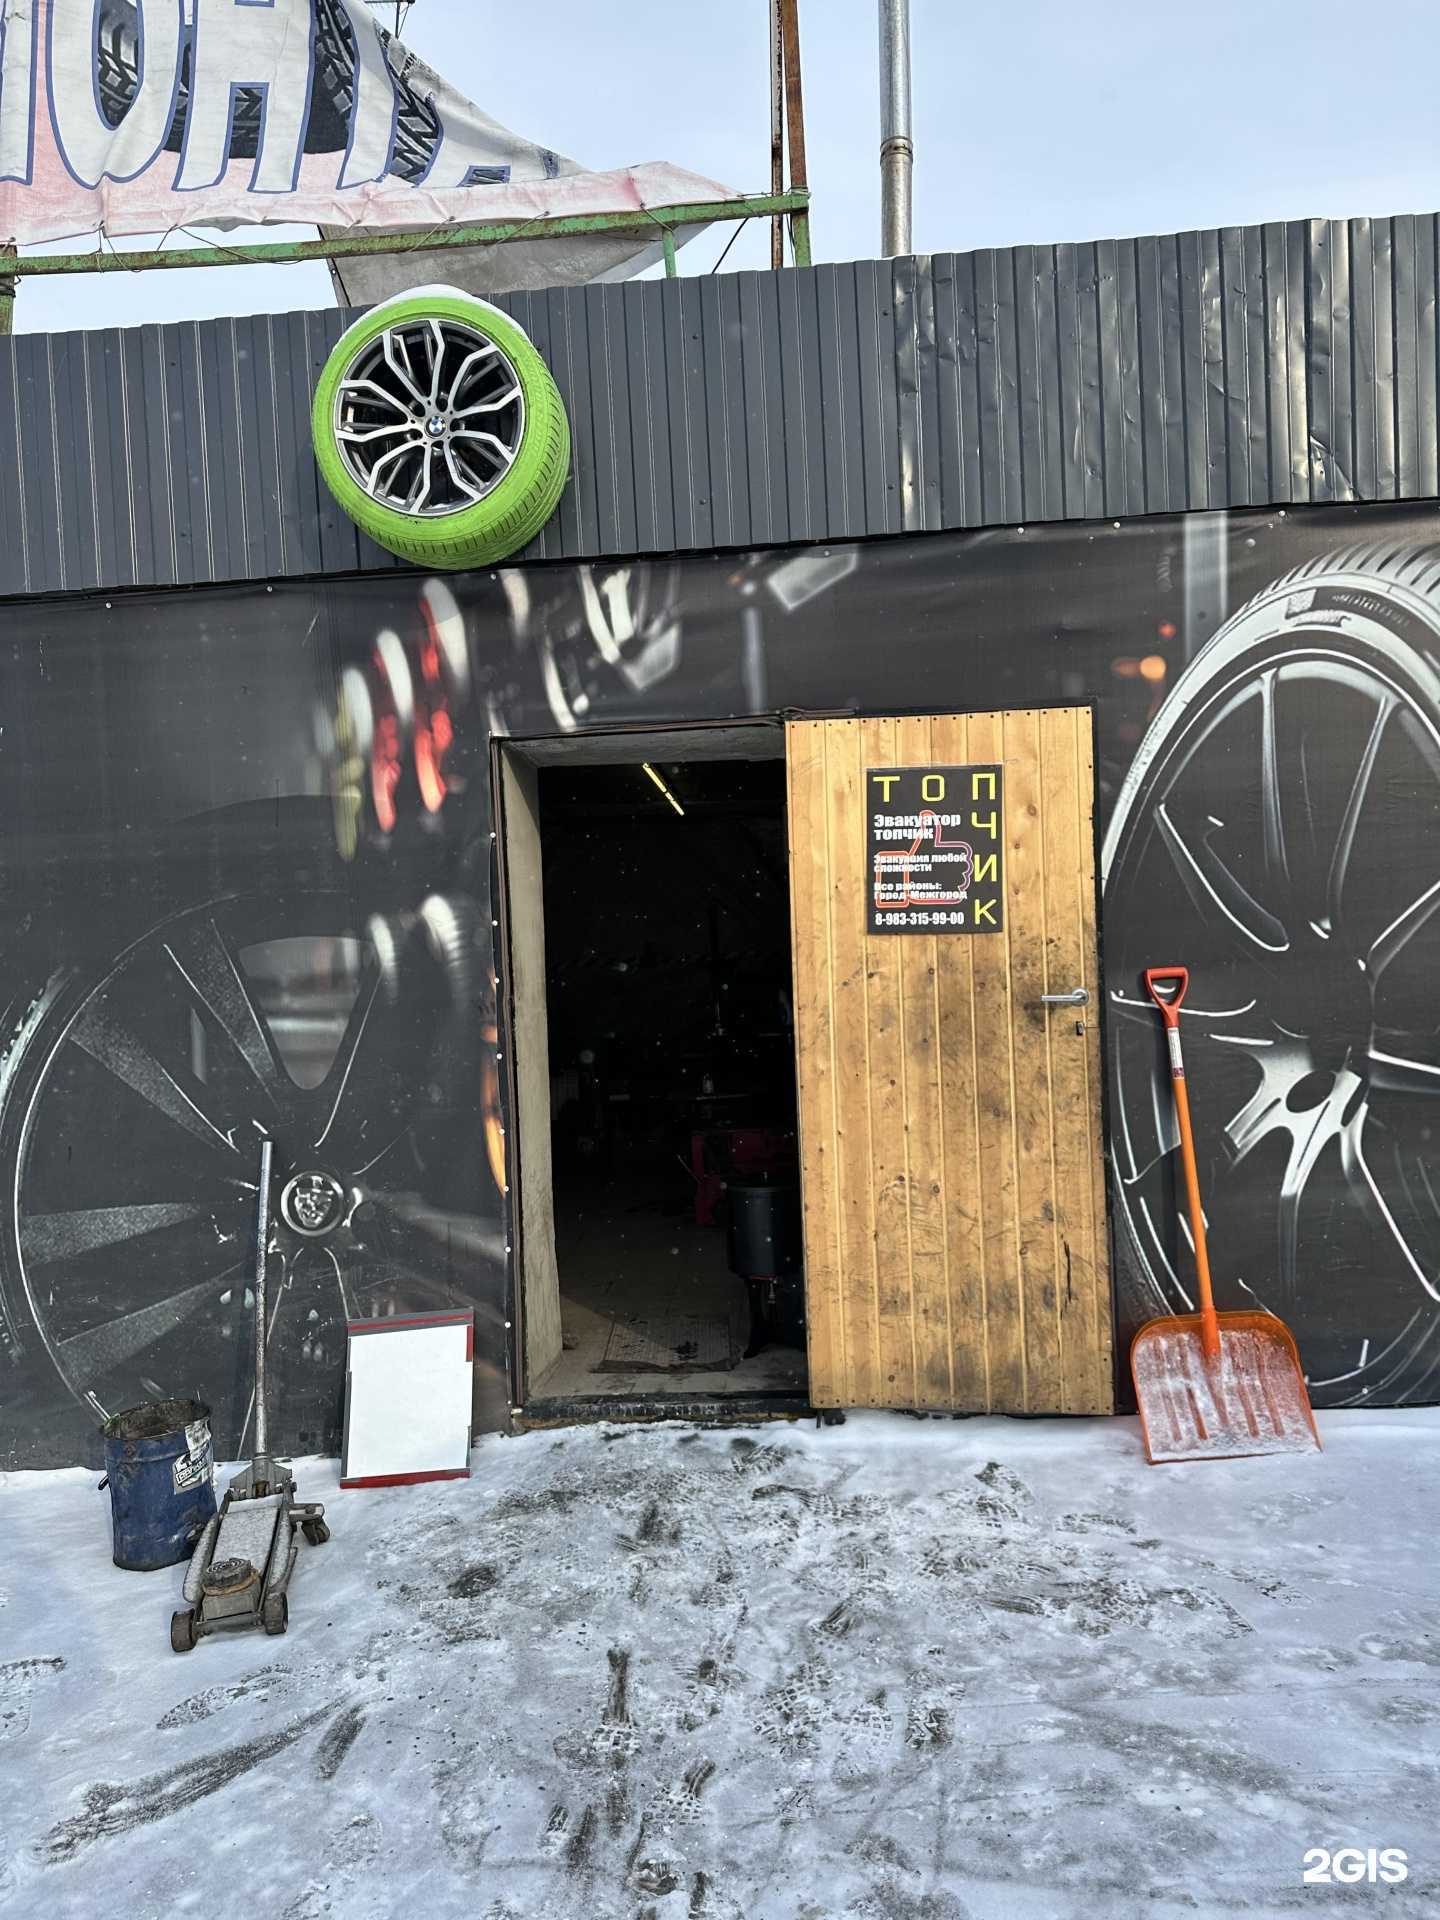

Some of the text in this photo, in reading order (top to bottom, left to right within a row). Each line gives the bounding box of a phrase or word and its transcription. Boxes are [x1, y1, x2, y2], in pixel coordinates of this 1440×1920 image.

[873, 814, 961, 828] Эвакуатор
[873, 828, 934, 841] топчик
[931, 852, 967, 863] любой
[873, 863, 932, 873] сложности
[873, 882, 894, 891] Все
